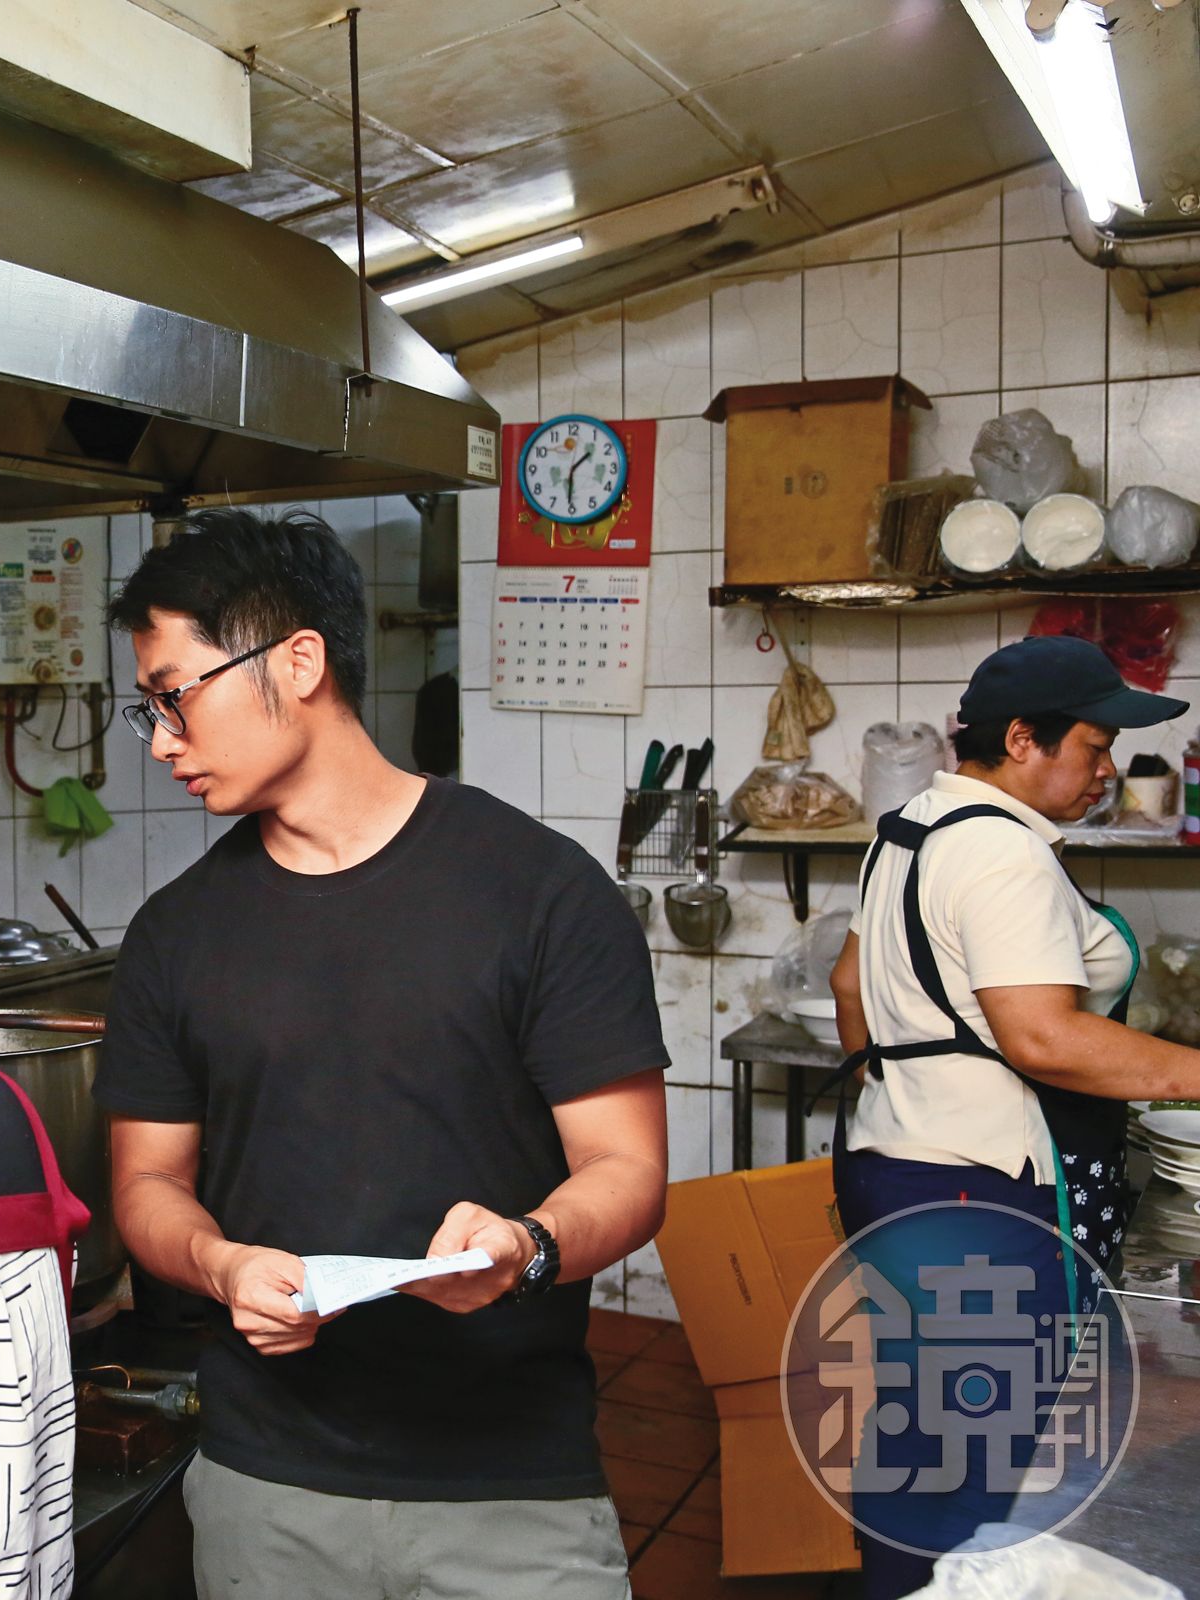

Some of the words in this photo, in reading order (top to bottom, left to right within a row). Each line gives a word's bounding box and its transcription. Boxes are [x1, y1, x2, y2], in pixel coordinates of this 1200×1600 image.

[568, 424, 579, 436] 12
[593, 429, 597, 441] 1
[551, 431, 559, 442] 11
[536, 447, 547, 458] 10
[603, 443, 612, 456] 2
[529, 464, 537, 476] 9
[609, 463, 617, 475] 3
[534, 483, 542, 495] 8
[603, 481, 612, 492] 4
[549, 496, 557, 508] 7
[588, 496, 597, 509] 5
[567, 503, 576, 515] 6
[562, 575, 576, 593] 7
